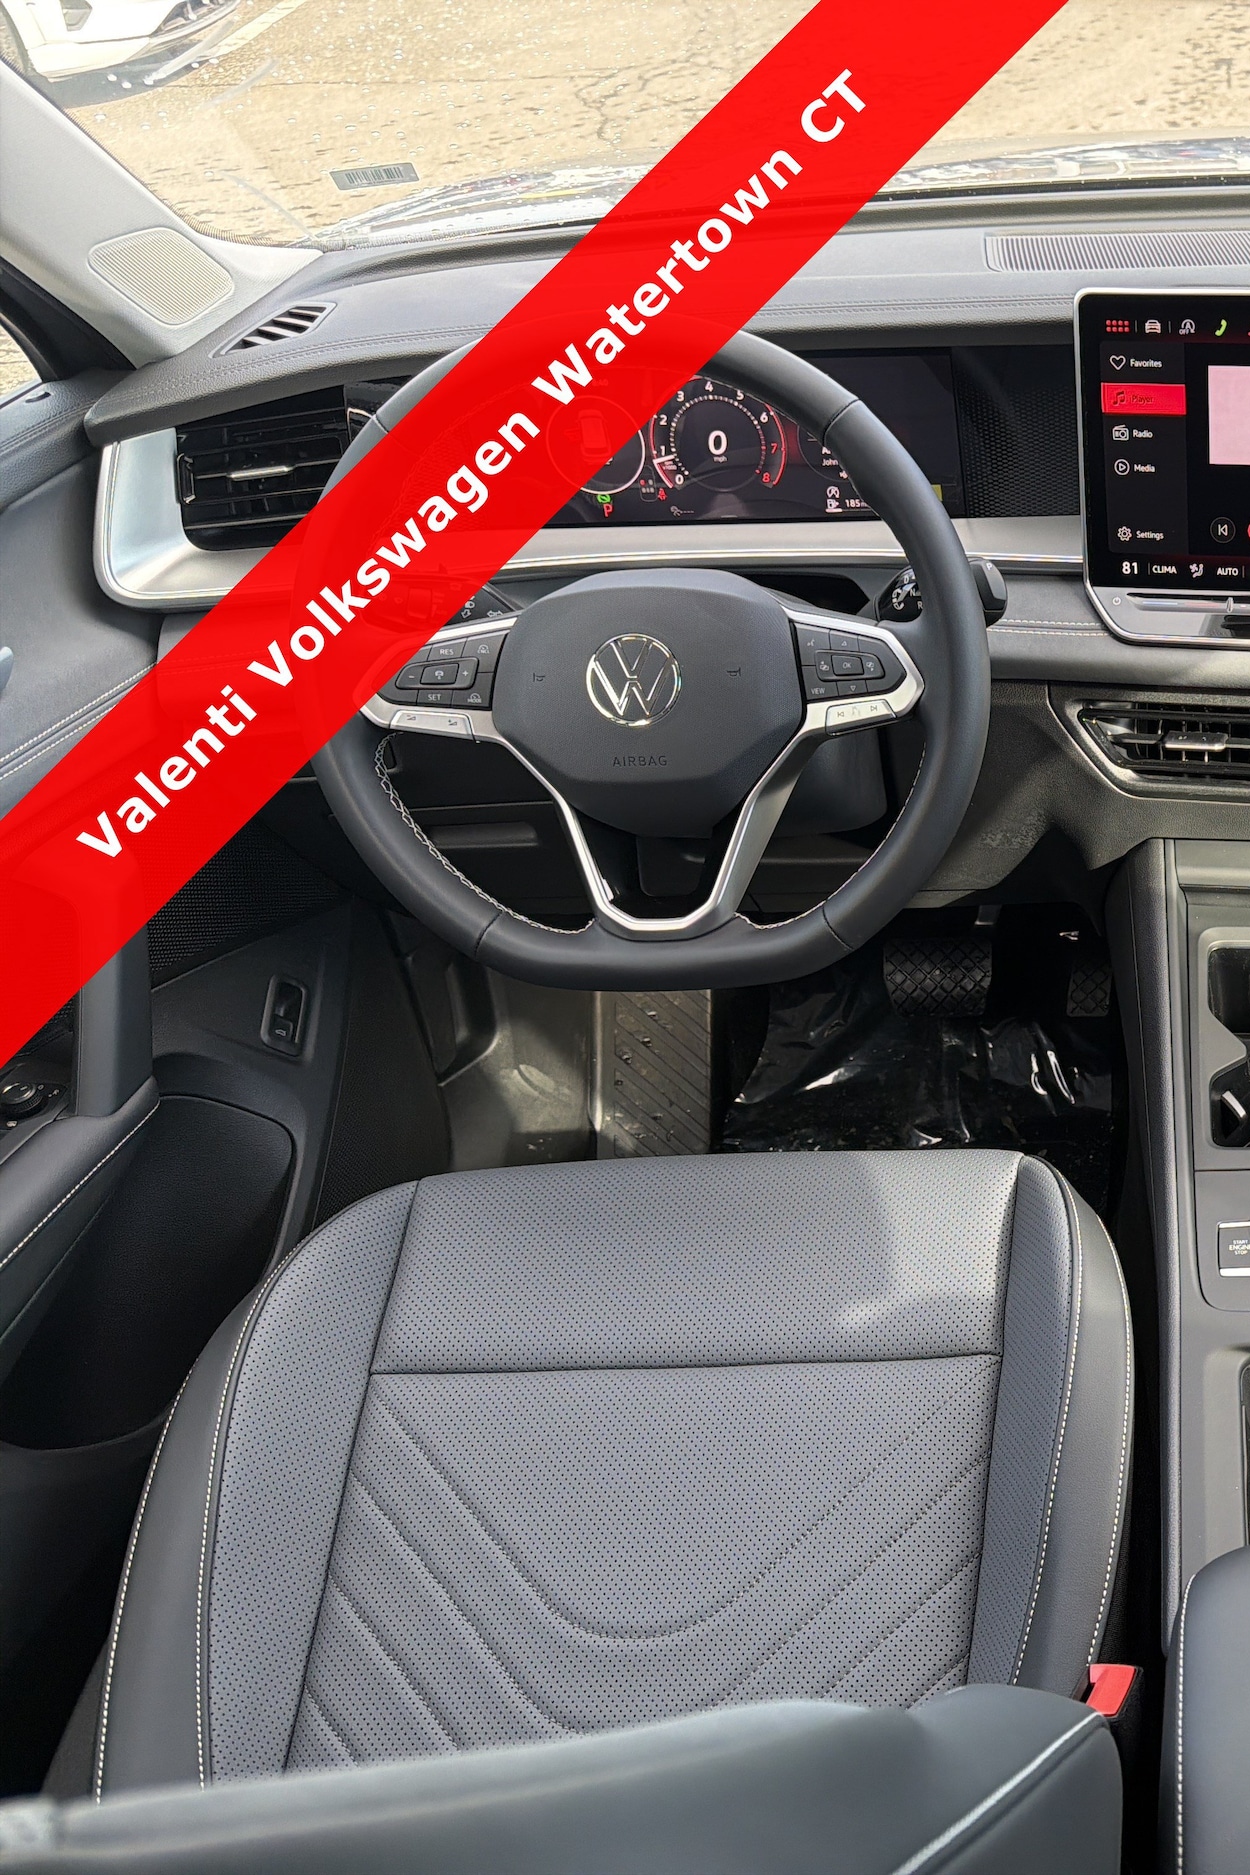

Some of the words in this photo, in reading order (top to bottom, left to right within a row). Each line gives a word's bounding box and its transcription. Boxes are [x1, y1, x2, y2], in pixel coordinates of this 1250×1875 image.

[1130, 358, 1163, 368] Favorites
[705, 381, 714, 392] 4
[677, 391, 685, 402] 3
[736, 390, 744, 401] 5
[660, 414, 668, 426] 2
[760, 411, 769, 423] 6
[1132, 429, 1154, 438] Radio
[708, 430, 728, 456] 0
[771, 443, 778, 454] 7
[660, 445, 666, 456] 1
[1134, 463, 1156, 473] Media
[675, 474, 684, 485] 0
[762, 472, 771, 483] 8
[845, 500, 860, 508] 185
[603, 504, 613, 517] P
[1136, 530, 1164, 541] Settings
[986, 562, 993, 571] P
[1122, 561, 1139, 575] 81
[1152, 564, 1177, 575] CLIMA
[1216, 567, 1239, 577] AUTO
[440, 648, 454, 656] RES
[843, 661, 852, 669] OK
[811, 687, 826, 695] VIEW
[428, 693, 442, 701] SET
[612, 755, 668, 767] AIRBAG
